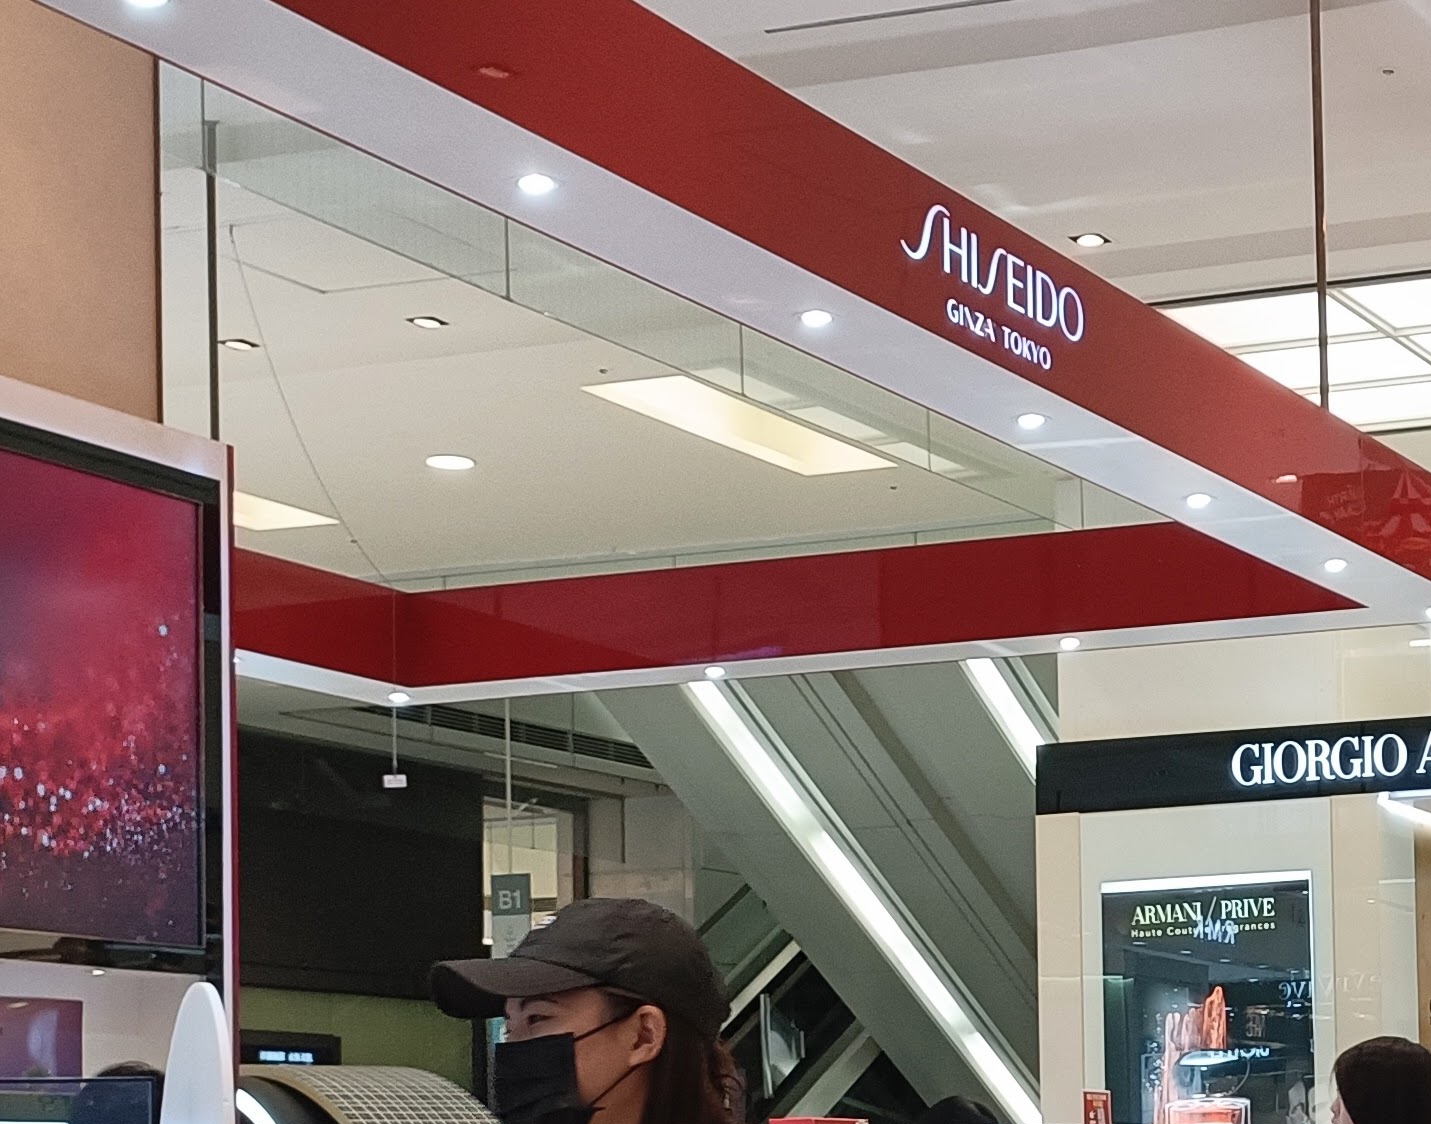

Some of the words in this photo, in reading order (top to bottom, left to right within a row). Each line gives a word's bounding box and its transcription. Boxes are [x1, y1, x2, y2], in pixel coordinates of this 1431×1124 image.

[900, 204, 1085, 342] SHISEIDO
[946, 298, 996, 342] GINZA
[1002, 325, 1053, 370] TOKYO
[1231, 733, 1408, 787] GIORGIO
[499, 889, 521, 910] B1
[1131, 902, 1203, 925] ARMANI
[1220, 897, 1275, 920] PRIVE
[1131, 927, 1163, 938] Haute
[1166, 923, 1210, 936] Coute
